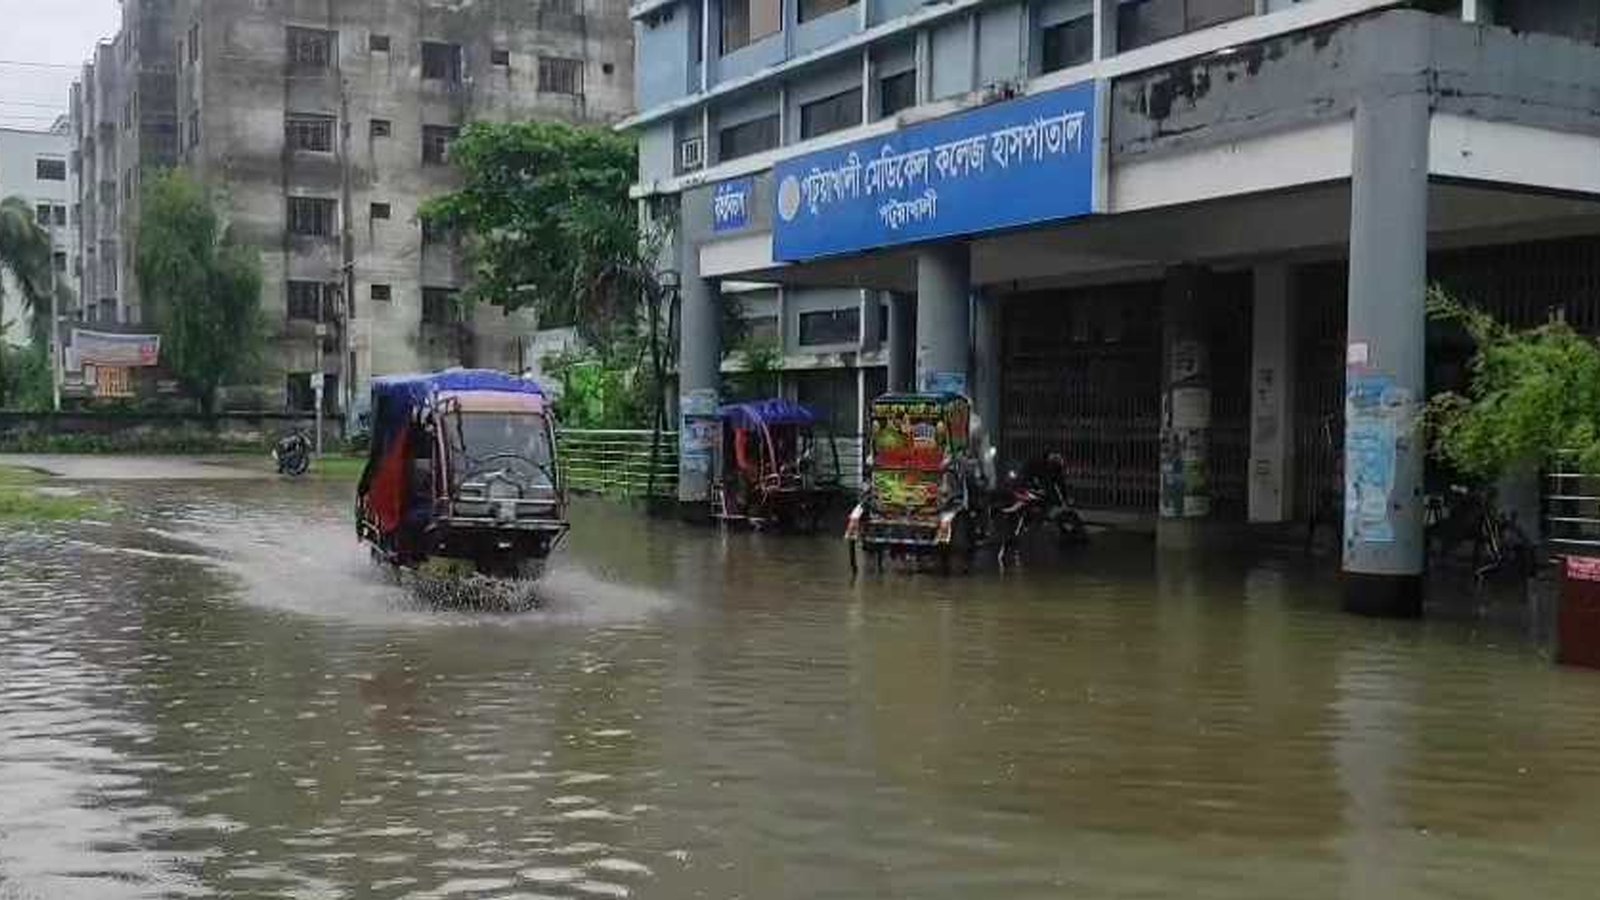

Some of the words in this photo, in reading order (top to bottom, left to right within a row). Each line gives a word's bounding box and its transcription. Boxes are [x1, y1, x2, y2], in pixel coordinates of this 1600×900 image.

[801, 151, 862, 215] পটুয়াখালী
[864, 144, 930, 196] মেডিকেল
[934, 134, 987, 178] কলেজ
[990, 110, 1085, 169] হাসপাতাল
[879, 188, 938, 230] পটুয়াখালী
